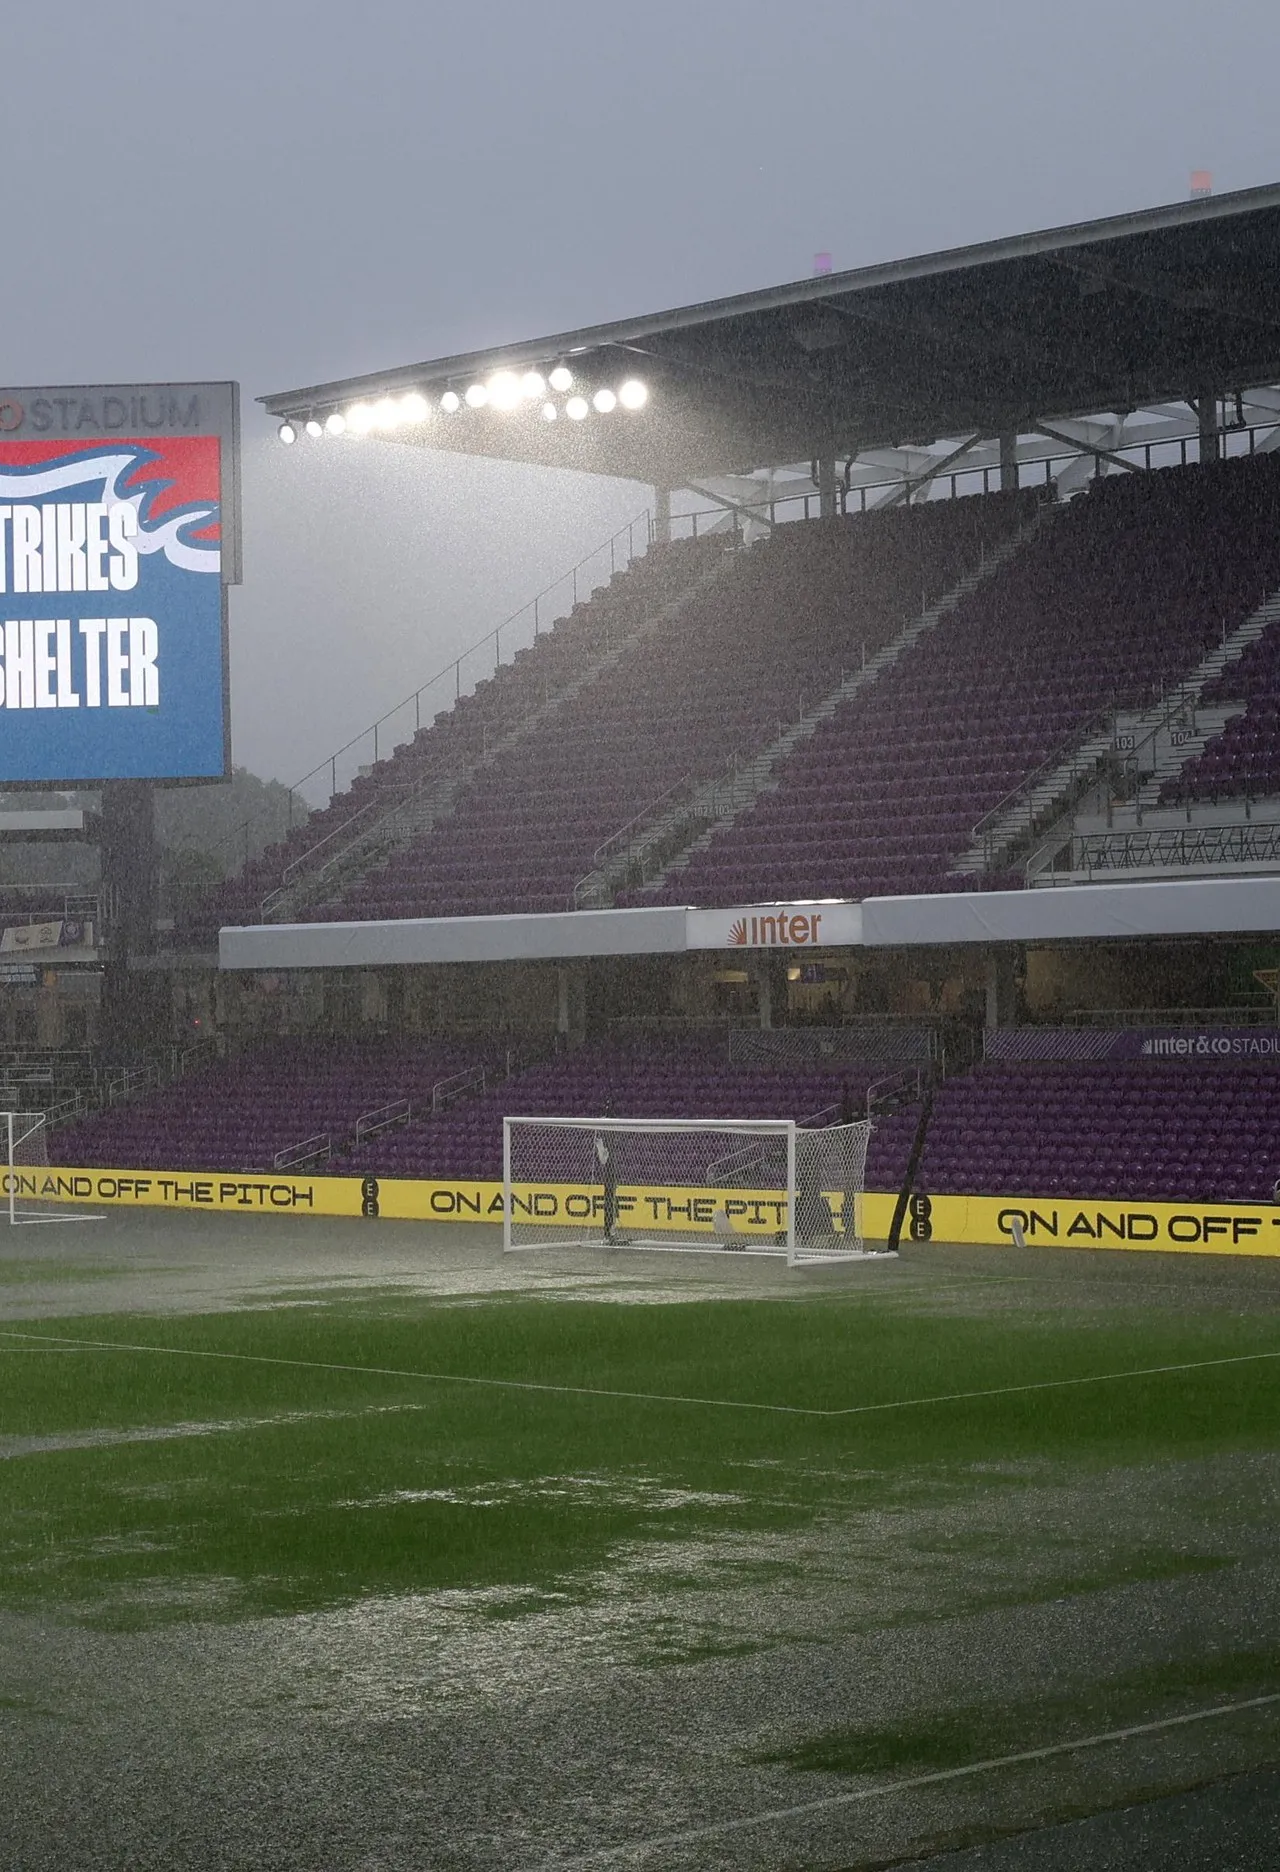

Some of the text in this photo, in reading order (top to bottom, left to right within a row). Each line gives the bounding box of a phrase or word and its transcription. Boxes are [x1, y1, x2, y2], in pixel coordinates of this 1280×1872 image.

[30, 395, 200, 432] STADIUM
[1116, 736, 1133, 749] 103
[3, 1175, 312, 1206] ON AND OFF THE PITCH
[430, 1191, 480, 1213] ON
[488, 1192, 558, 1216] AND
[565, 1195, 637, 1218] OFF
[645, 1197, 716, 1222] THE
[998, 1210, 1262, 1244] ON AND OFF
